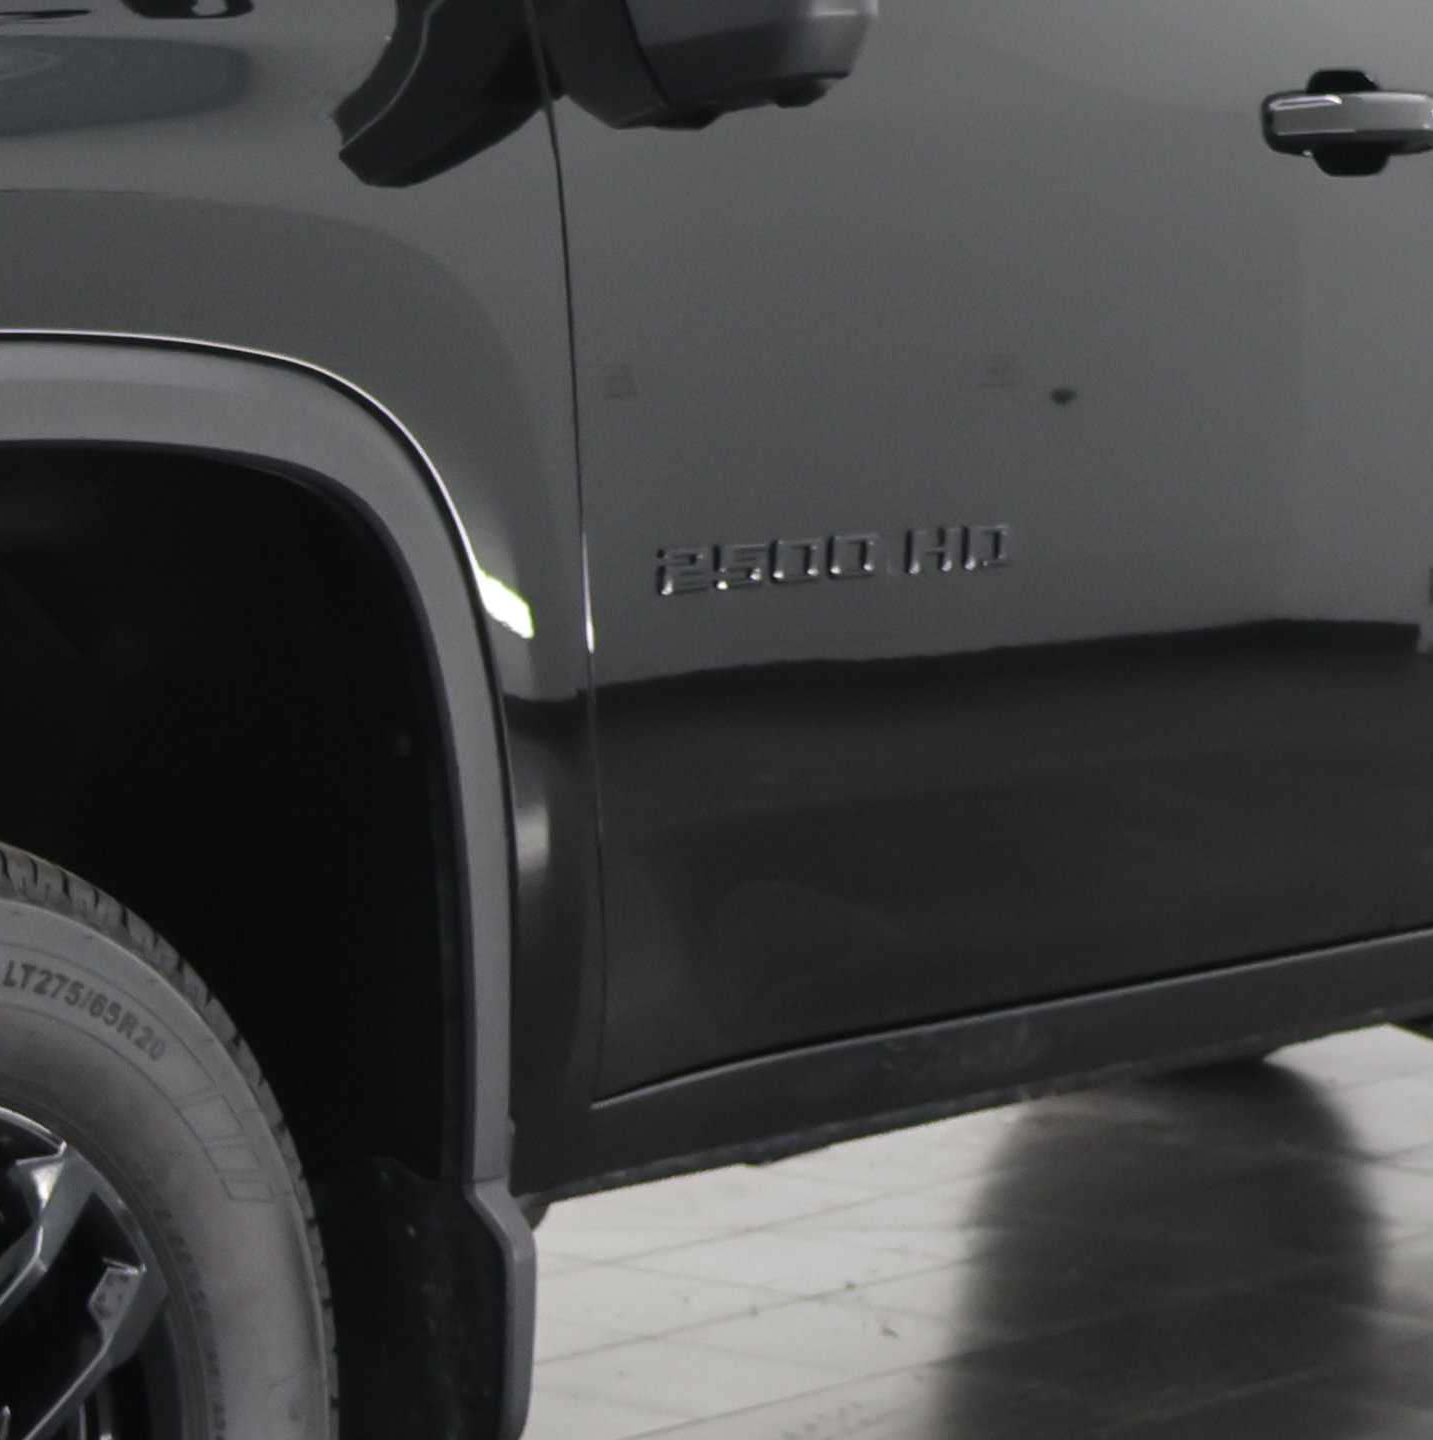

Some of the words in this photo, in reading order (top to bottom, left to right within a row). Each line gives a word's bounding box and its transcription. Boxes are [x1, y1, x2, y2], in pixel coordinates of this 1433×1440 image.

[655, 532, 880, 596] 2500
[904, 521, 1012, 575] HD
[0, 960, 168, 1062] LT275/65R20
